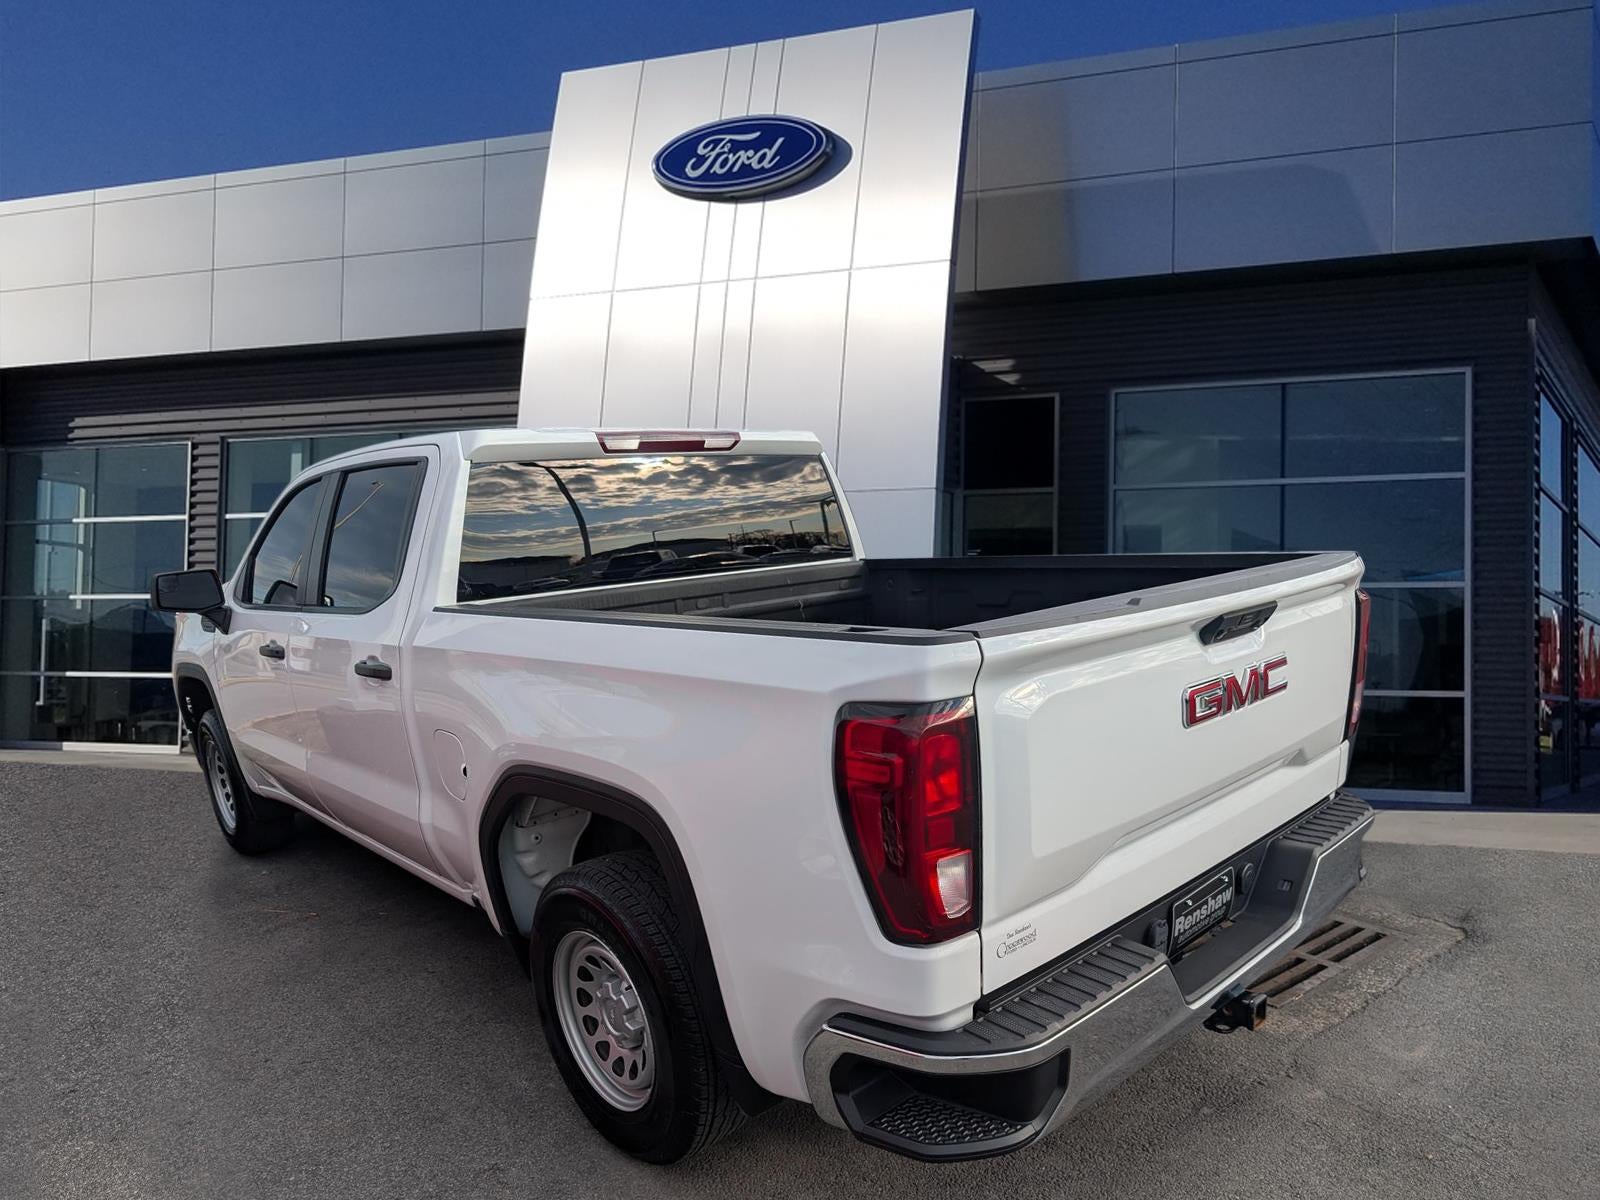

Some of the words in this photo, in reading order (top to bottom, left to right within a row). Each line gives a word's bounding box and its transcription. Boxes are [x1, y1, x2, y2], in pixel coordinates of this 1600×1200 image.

[685, 131, 784, 178] Ford
[1181, 653, 1288, 729] GMC
[1174, 887, 1233, 937] Renshaw
